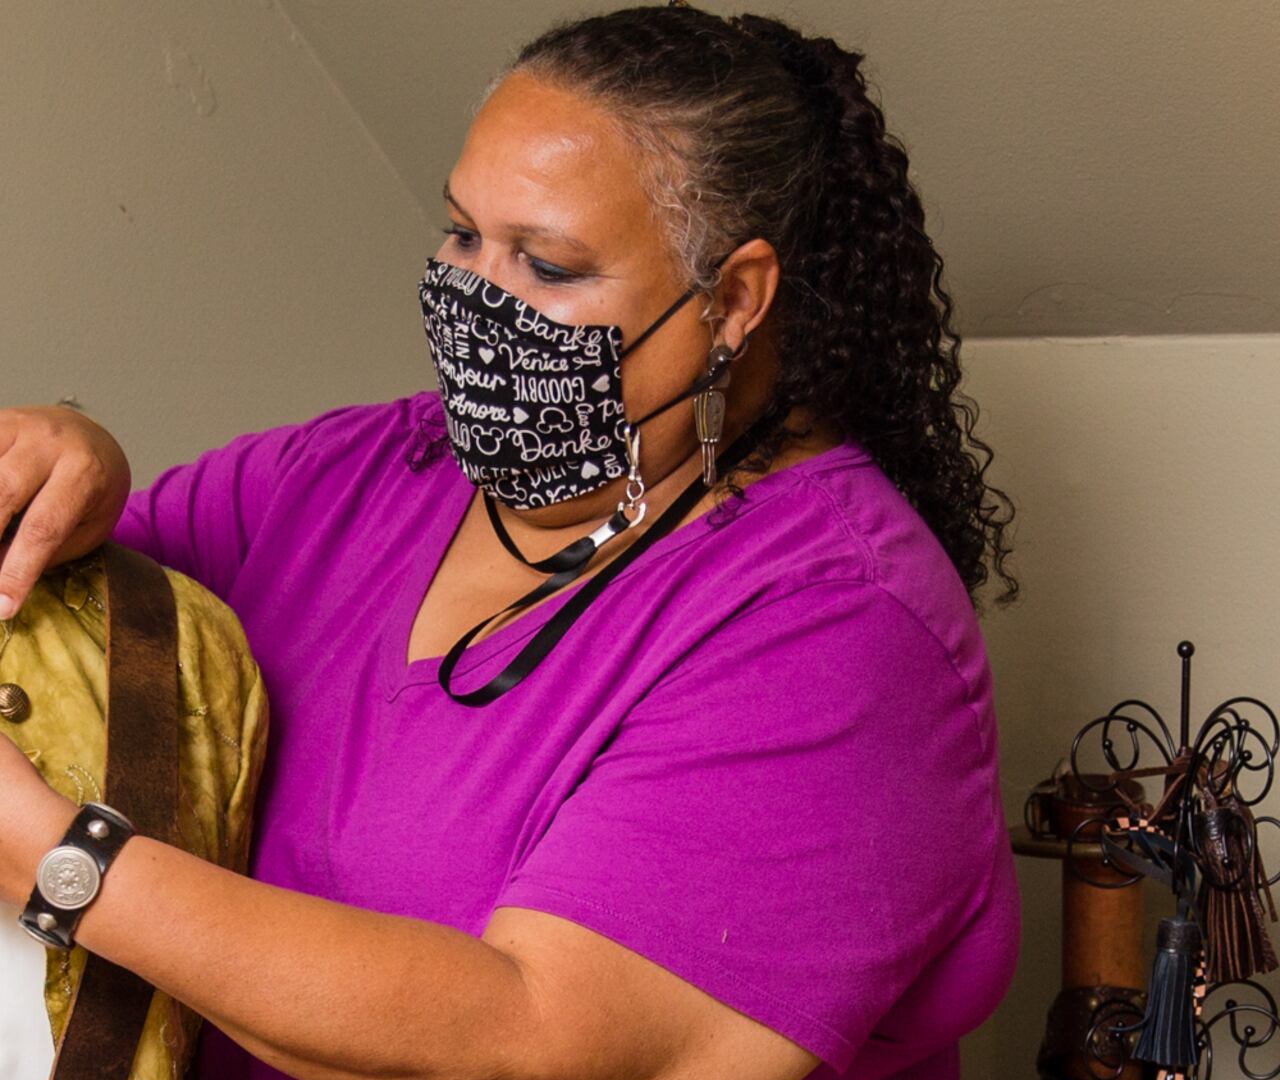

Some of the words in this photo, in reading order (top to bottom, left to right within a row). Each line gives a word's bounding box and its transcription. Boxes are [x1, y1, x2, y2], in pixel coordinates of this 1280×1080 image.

[499, 343, 568, 372] Venice
[512, 375, 585, 403] GOODBYE
[449, 393, 510, 421] Amore
[506, 429, 612, 462] Danke
